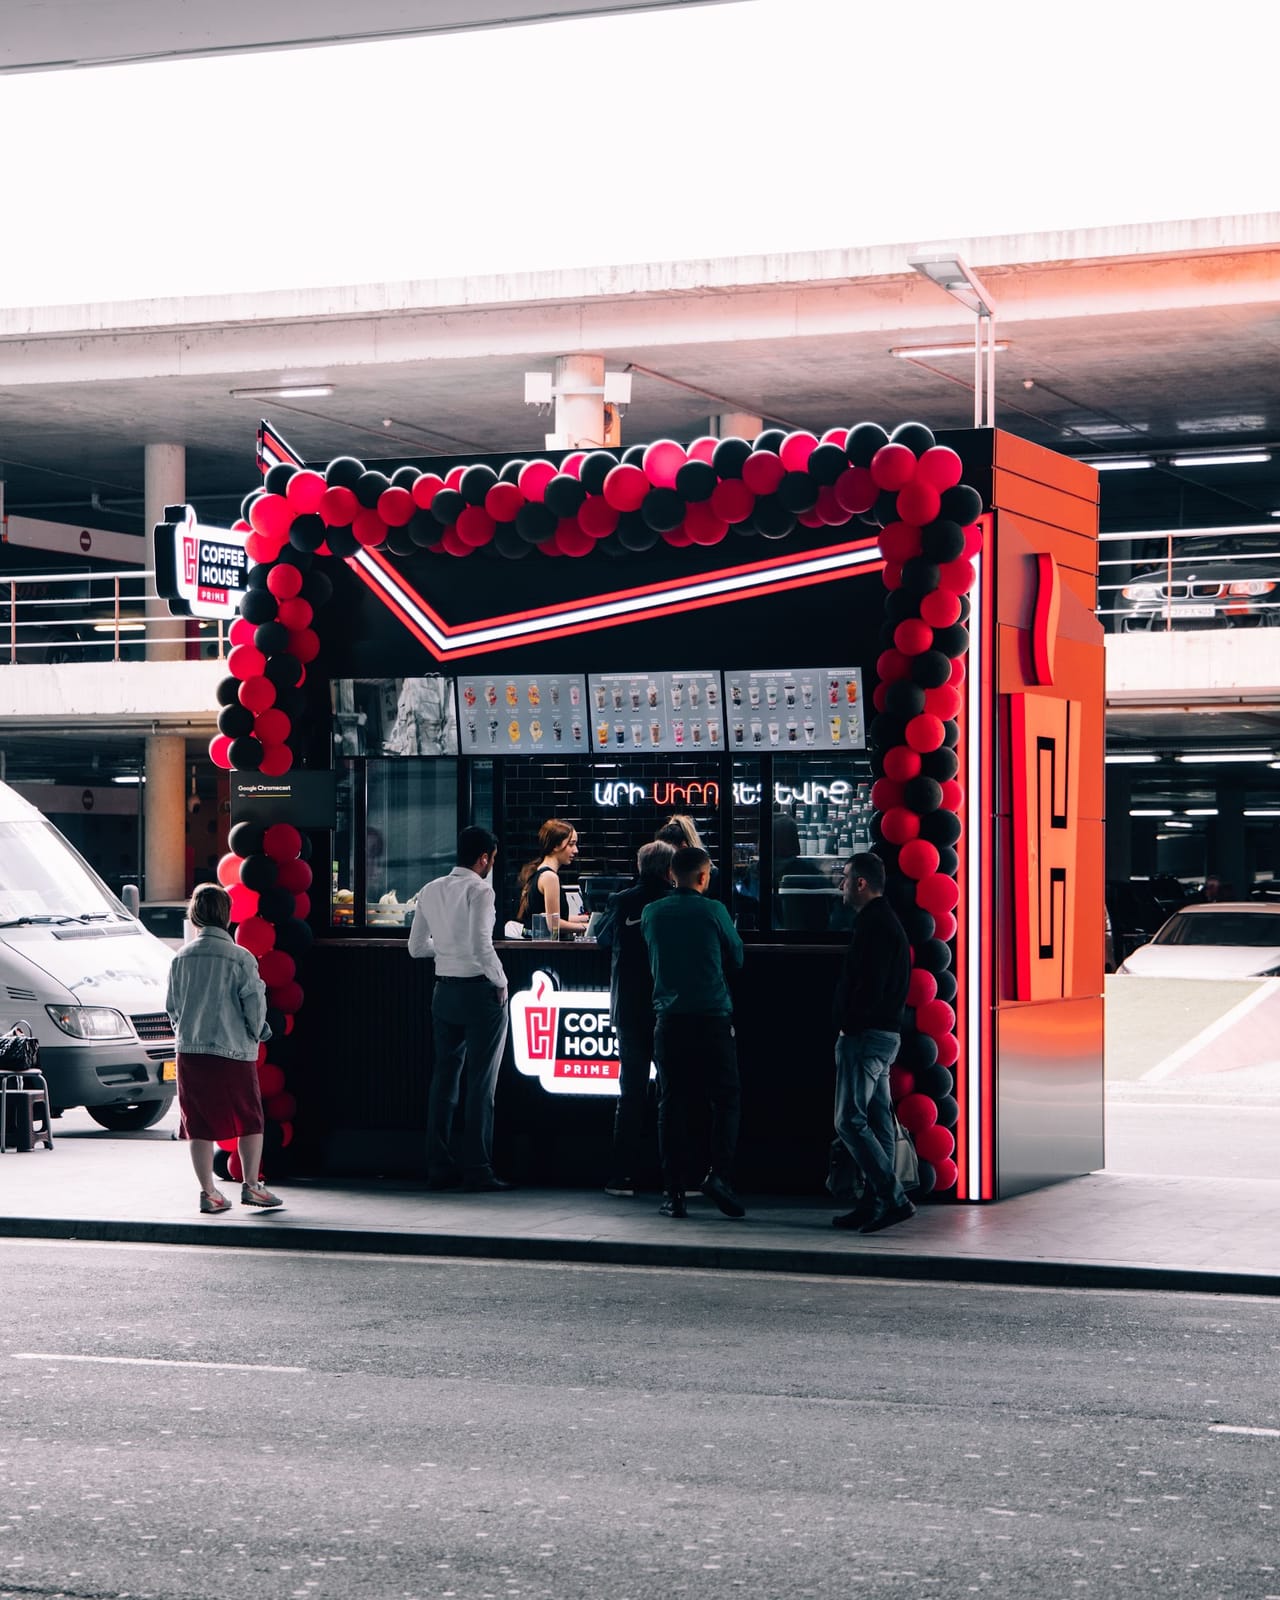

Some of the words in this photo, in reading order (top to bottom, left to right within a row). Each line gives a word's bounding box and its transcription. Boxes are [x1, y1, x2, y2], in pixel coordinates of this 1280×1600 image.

[201, 545, 245, 567] COFFEE
[201, 566, 240, 587] HOUSE
[201, 591, 225, 602] PRIME
[564, 1013, 617, 1033] COF
[564, 1064, 610, 1075] PRIME
